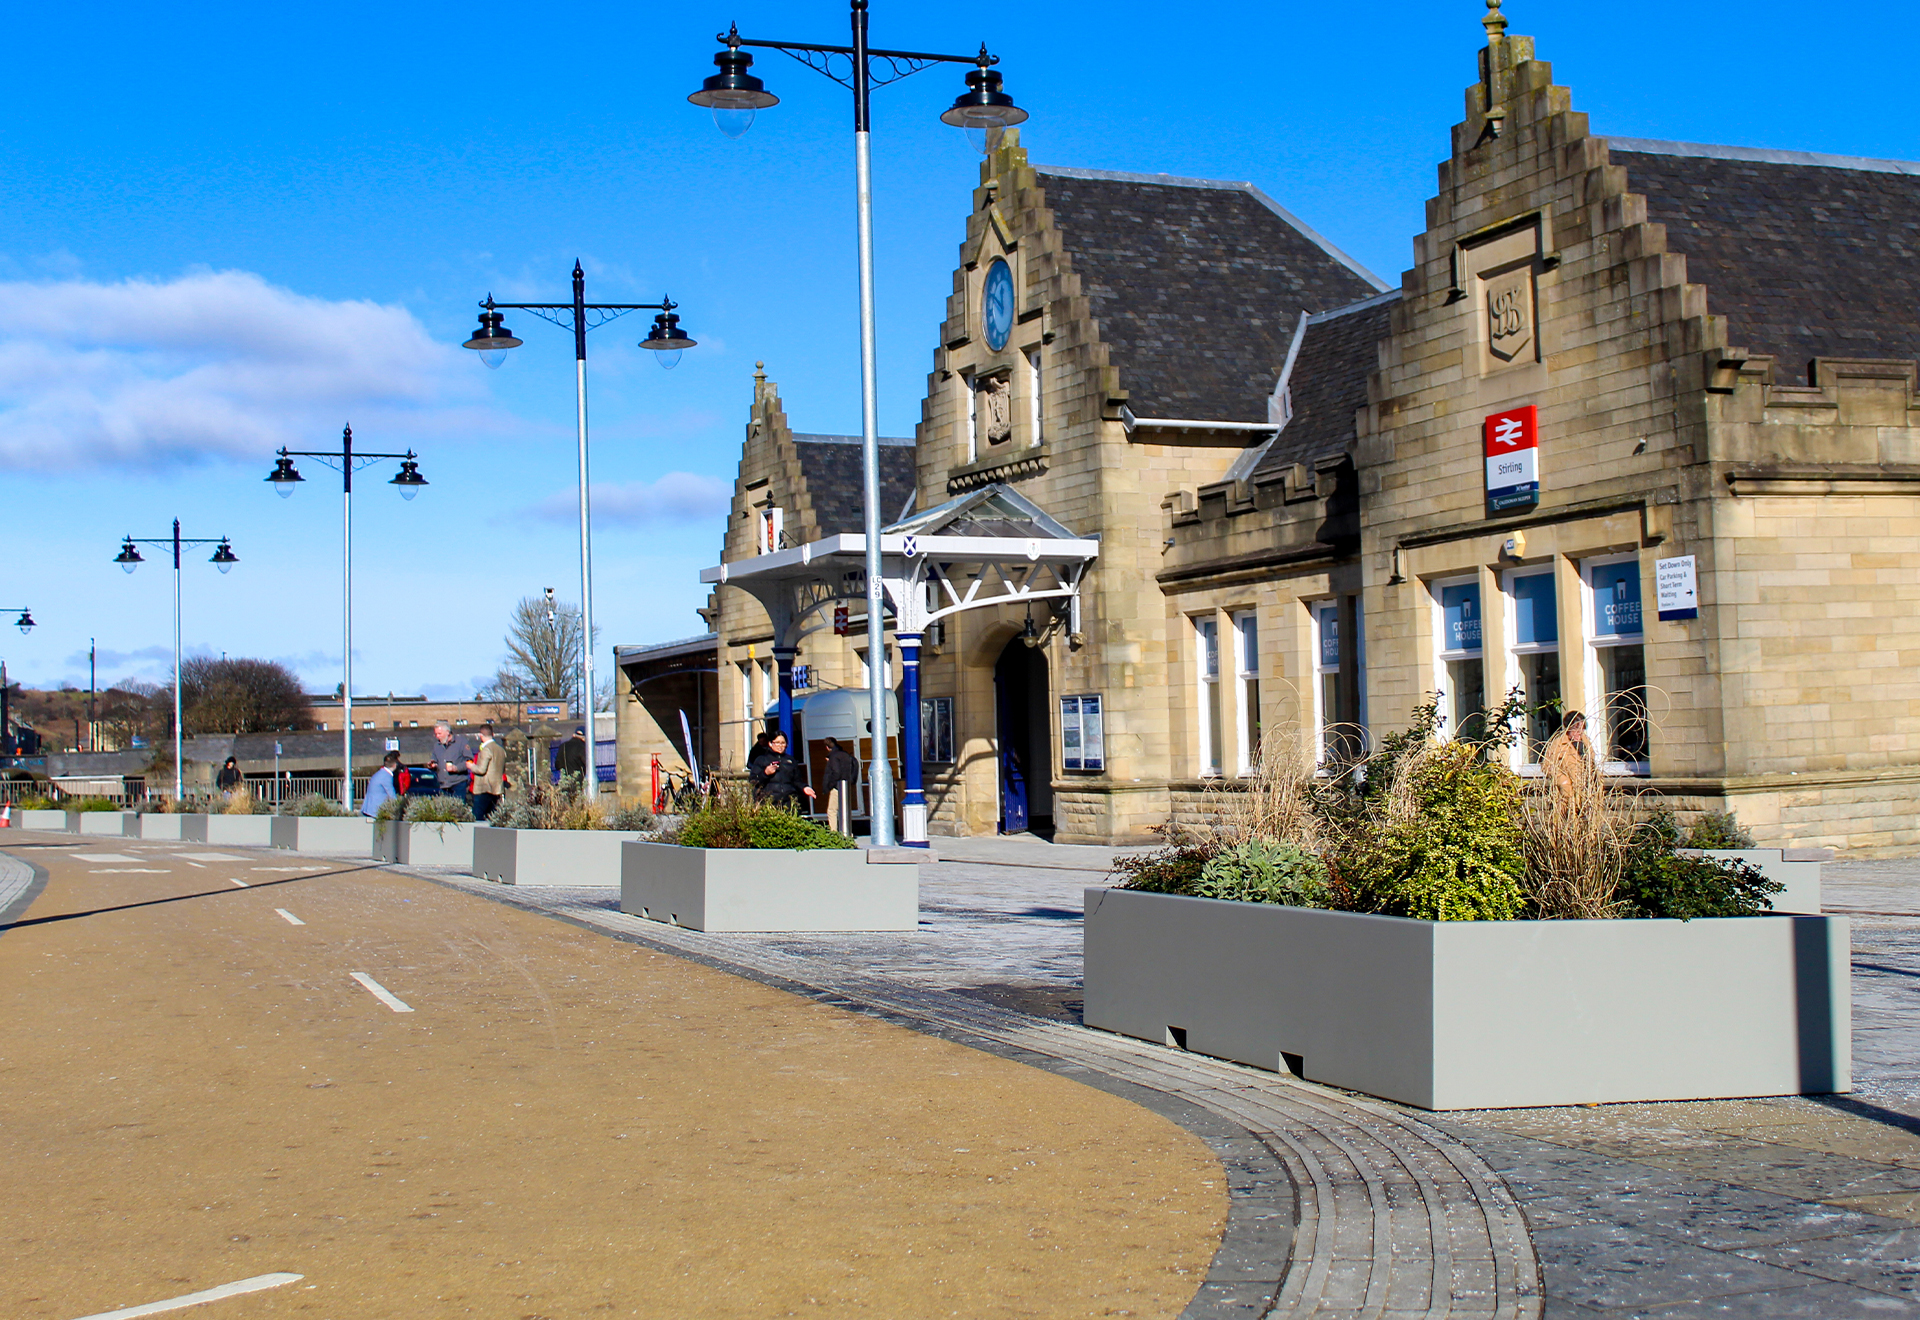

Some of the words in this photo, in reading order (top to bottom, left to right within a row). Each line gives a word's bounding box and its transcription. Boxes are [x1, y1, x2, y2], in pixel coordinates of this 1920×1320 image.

[1498, 461, 1522, 475] Stirling
[1667, 561, 1681, 569] Down
[1680, 559, 1692, 568] Only
[1667, 572, 1683, 580] Parking
[874, 590, 881, 598] 9
[1604, 601, 1641, 615] COFFEE
[1607, 613, 1639, 626] HOUSE
[1455, 630, 1482, 641] HOUSE
